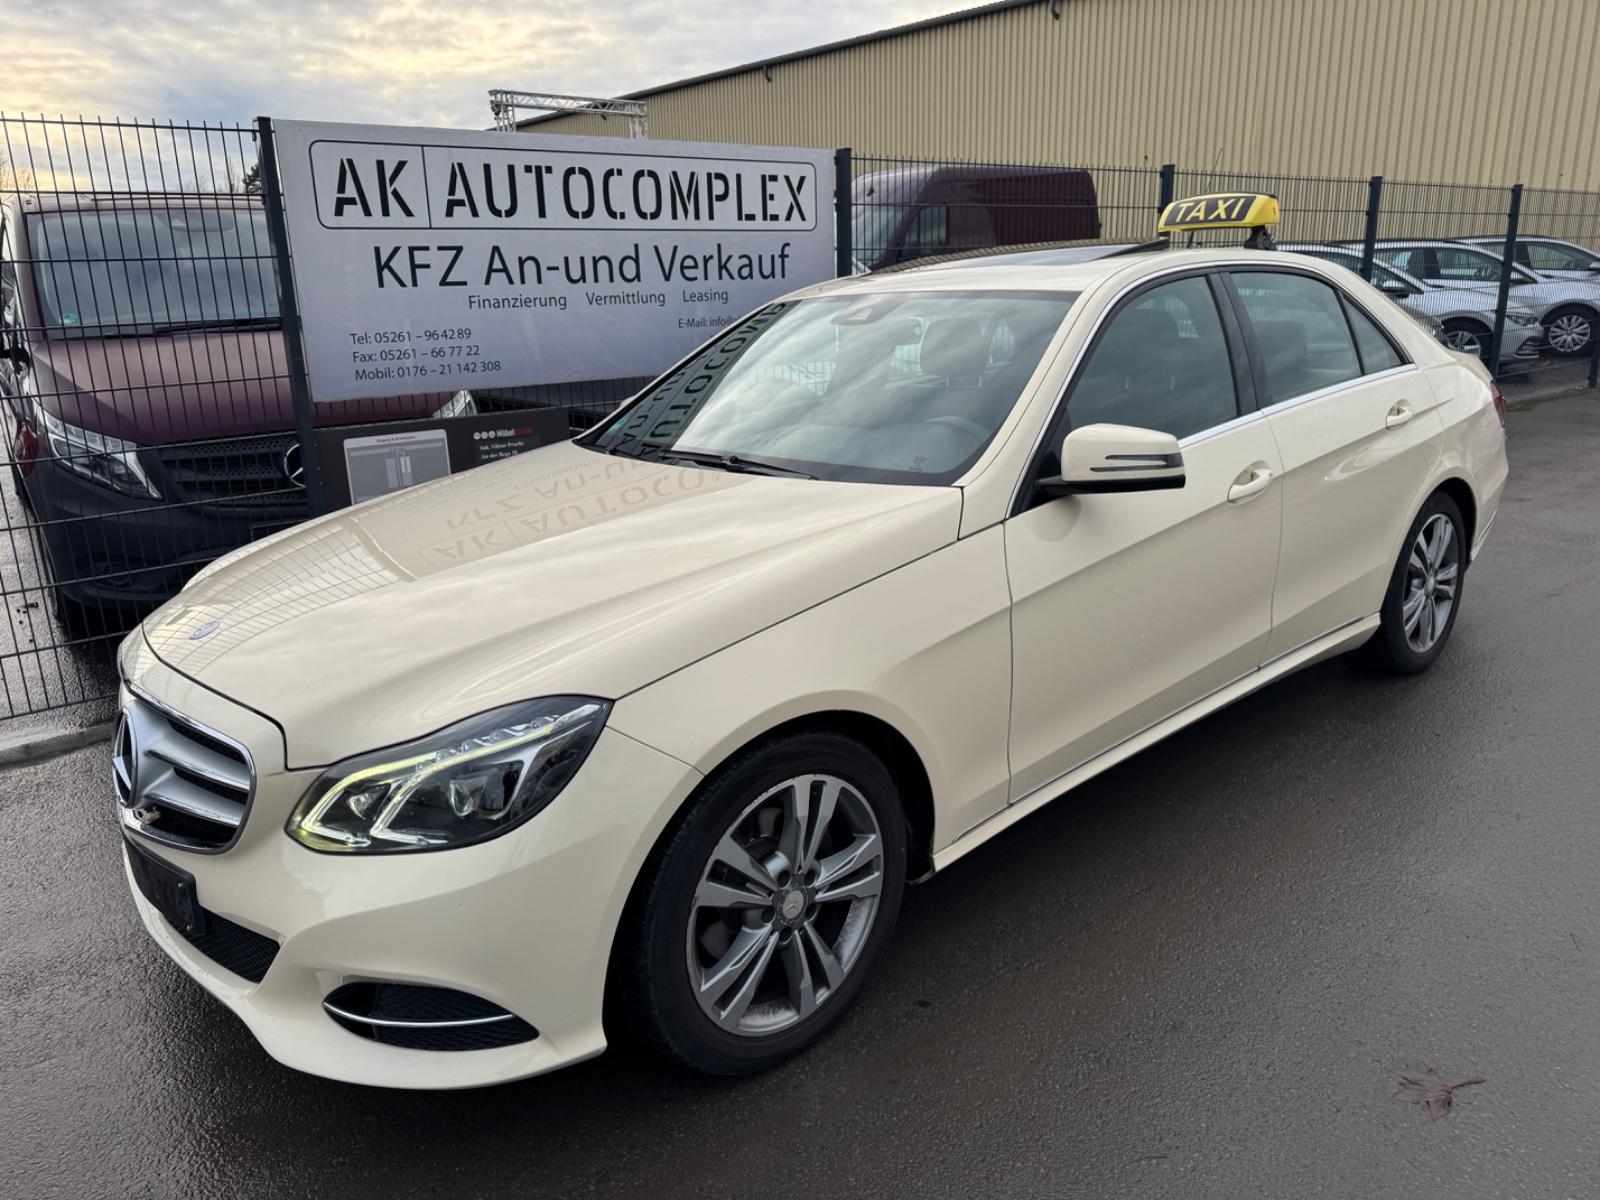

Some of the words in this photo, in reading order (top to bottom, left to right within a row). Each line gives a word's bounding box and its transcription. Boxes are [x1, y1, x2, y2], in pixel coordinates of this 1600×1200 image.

[334, 158, 415, 217] AK
[445, 162, 807, 221] AUTOCOMPLEX
[1175, 198, 1246, 222] TAXI
[373, 245, 468, 288] KFZ
[484, 243, 642, 285] An-und
[653, 242, 791, 282] Verkauf
[468, 294, 567, 310] Finanzierung
[586, 291, 666, 307] Vermittlung
[682, 289, 728, 304] Leasing
[678, 317, 708, 329] E-Mail:
[350, 333, 372, 345] Tel:
[374, 331, 411, 344] 05261
[352, 351, 377, 363] Fax:
[380, 349, 417, 361] 05261
[355, 367, 394, 381] Mobil:
[397, 365, 428, 378] 0176
